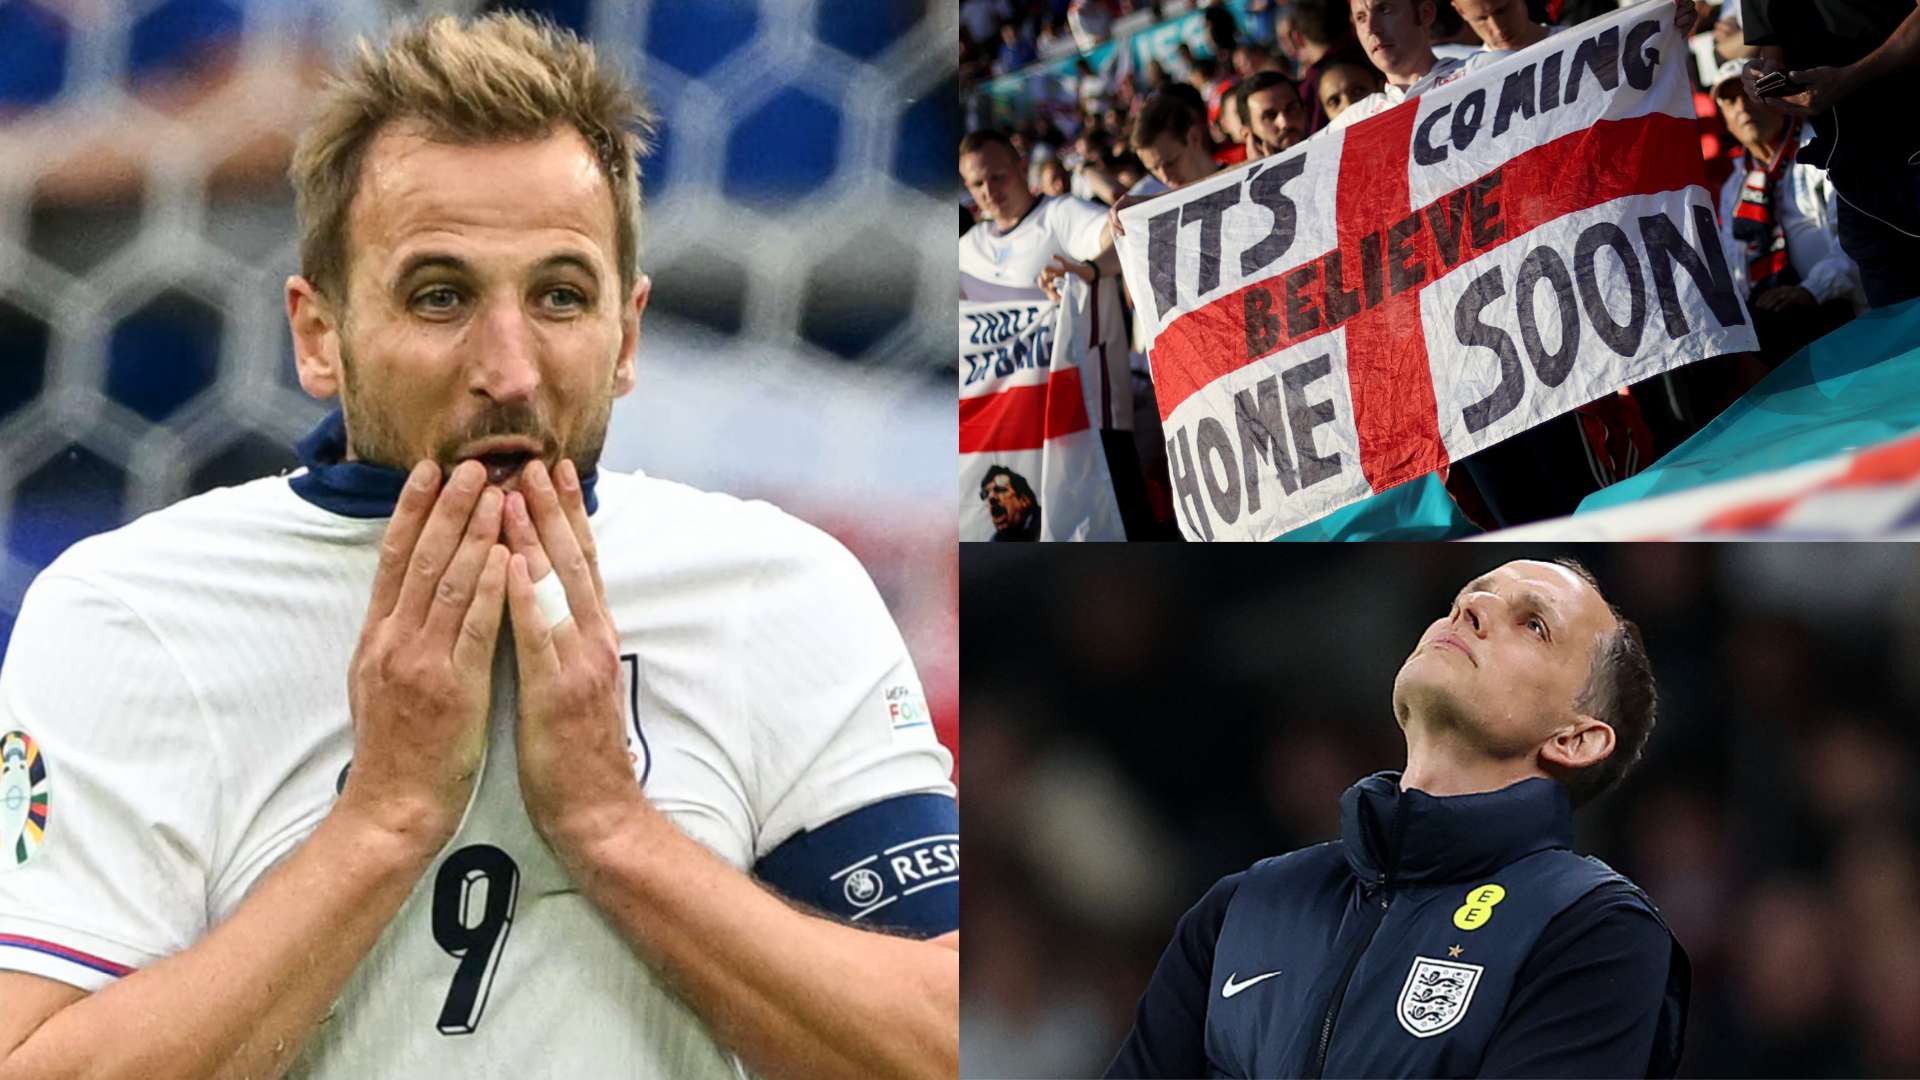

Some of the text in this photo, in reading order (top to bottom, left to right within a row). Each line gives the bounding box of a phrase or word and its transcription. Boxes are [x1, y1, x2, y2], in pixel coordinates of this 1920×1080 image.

[1148, 20, 1661, 321] IT'S COMING
[1244, 175, 1505, 357] BELIEVE
[1168, 205, 1745, 541] HOME SOON
[431, 843, 520, 1035] 9
